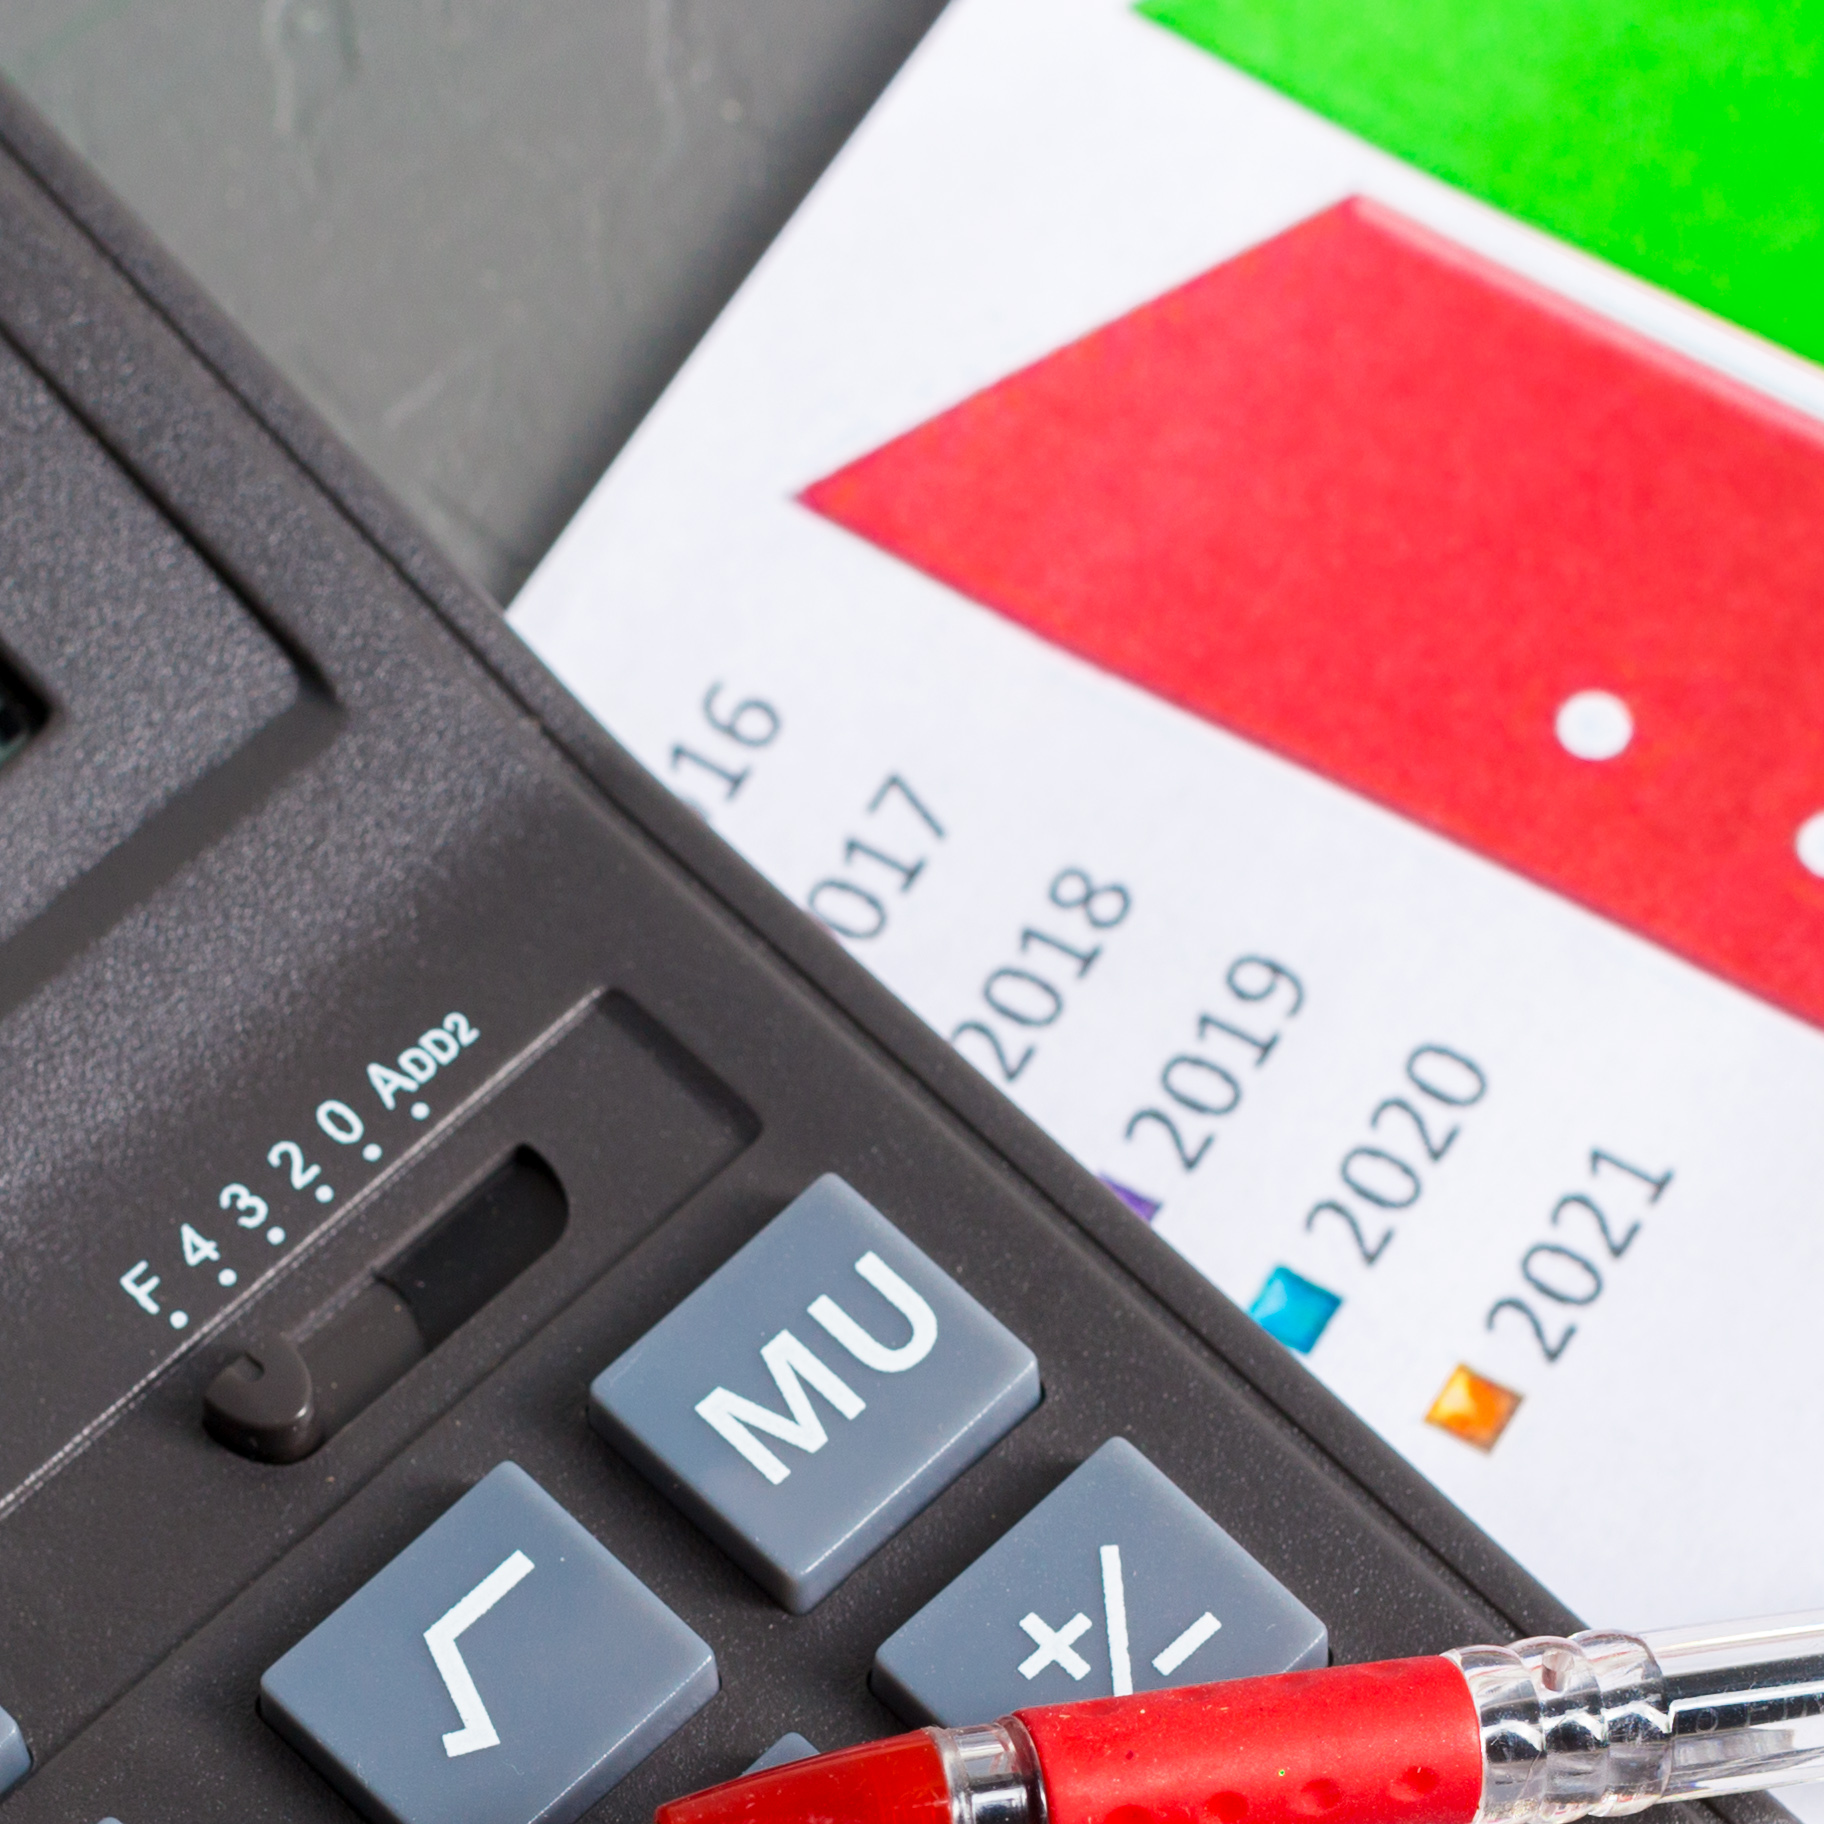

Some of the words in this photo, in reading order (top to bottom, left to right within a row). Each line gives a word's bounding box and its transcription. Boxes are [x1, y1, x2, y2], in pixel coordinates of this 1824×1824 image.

[669, 680, 781, 812] 16
[805, 771, 946, 941] 017
[949, 866, 1133, 1084] 2018
[1124, 953, 1305, 1173] 2019
[121, 1261, 159, 1314] F
[181, 1224, 219, 1265] 4
[218, 1183, 269, 1229] 3
[267, 1141, 321, 1189] 2
[317, 1101, 363, 1143] 0
[1304, 1042, 1488, 1267] 2020
[1485, 1147, 1675, 1365] 2021
[694, 1251, 940, 1485] MU
